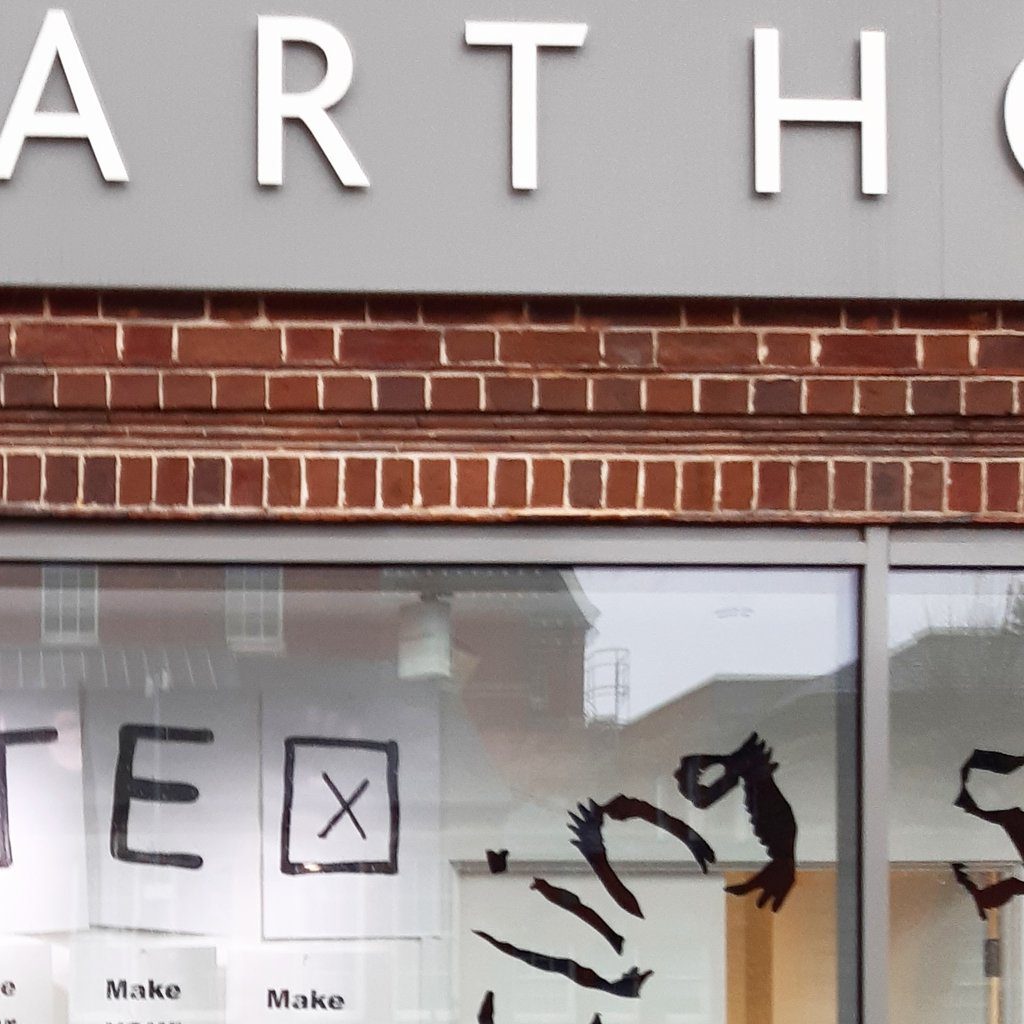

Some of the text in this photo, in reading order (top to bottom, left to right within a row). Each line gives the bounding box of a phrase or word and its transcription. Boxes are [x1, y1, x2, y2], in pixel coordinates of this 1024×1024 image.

[750, 27, 1024, 197] H
[106, 979, 181, 1000] Make
[267, 989, 345, 1010] Make
